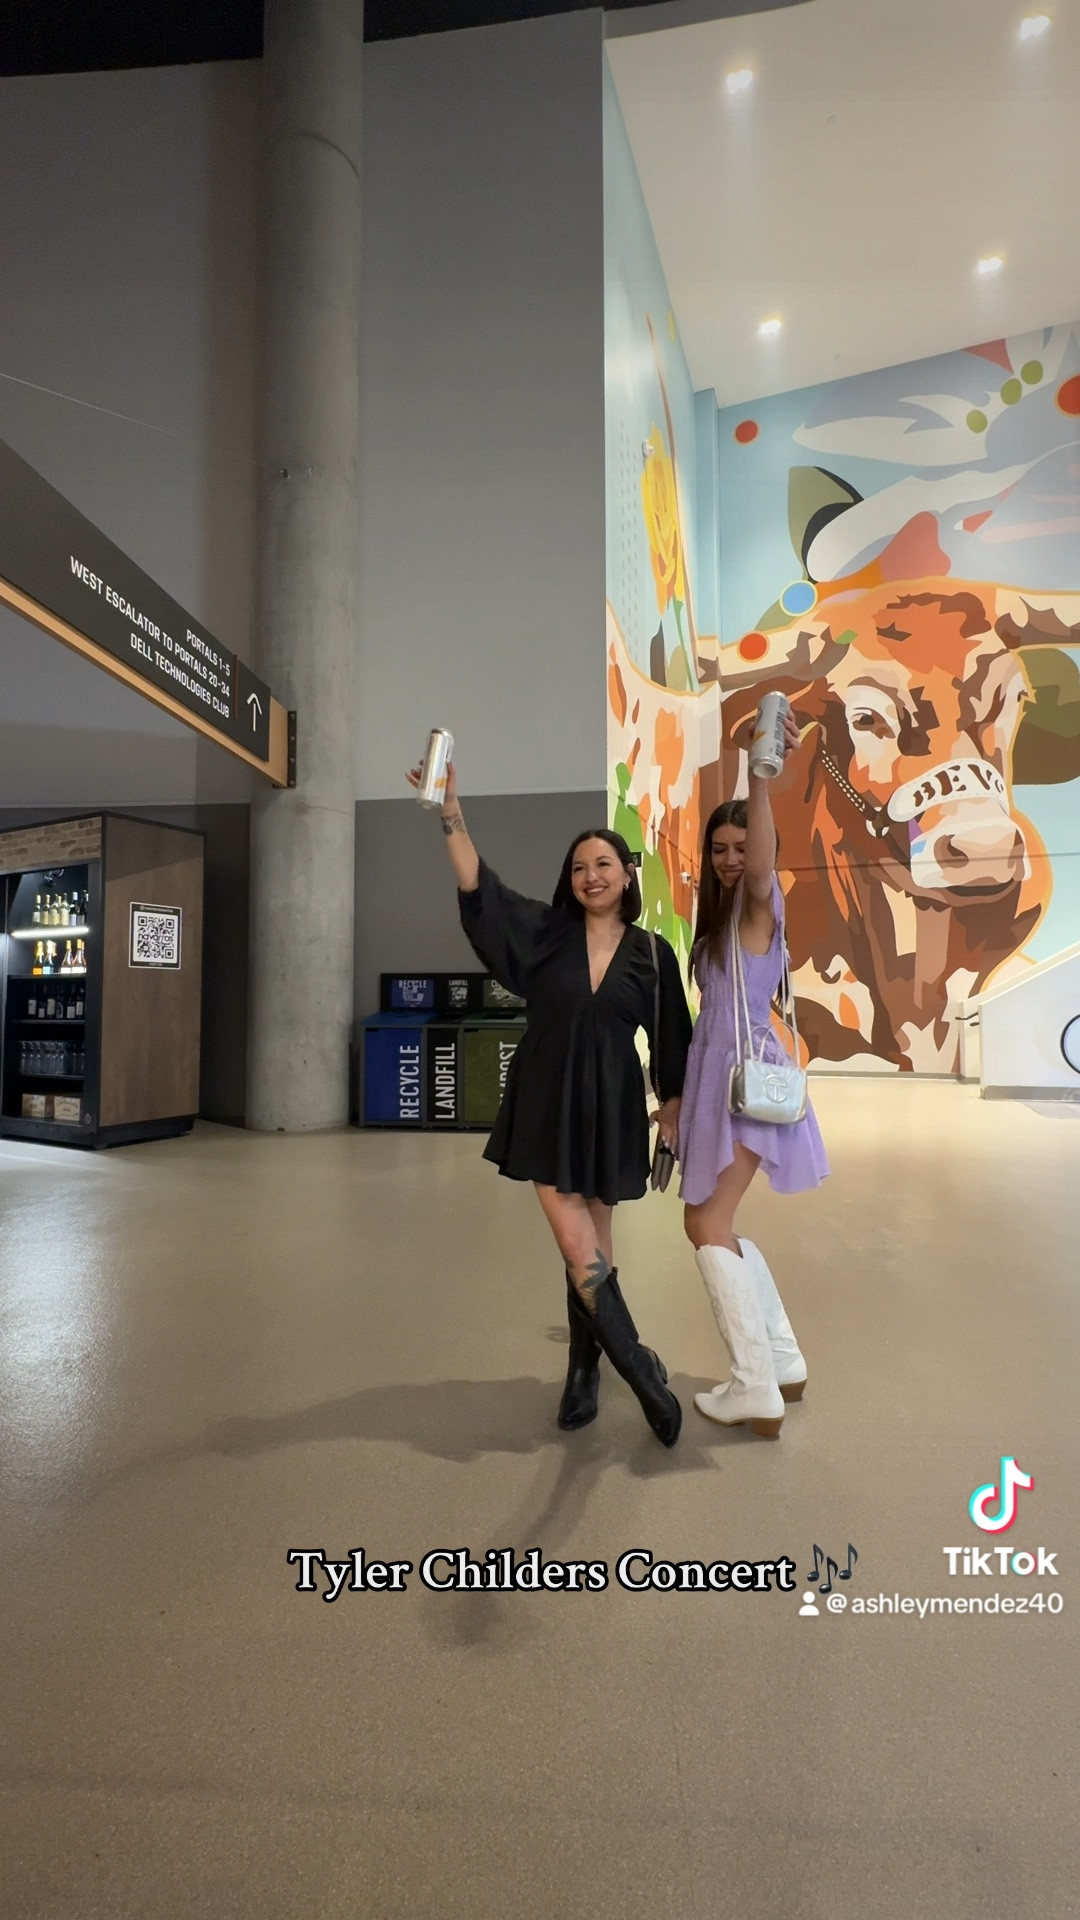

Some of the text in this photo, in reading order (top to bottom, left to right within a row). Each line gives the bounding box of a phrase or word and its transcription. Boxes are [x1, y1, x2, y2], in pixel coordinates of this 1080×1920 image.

[70, 555, 230, 697] WEST ESCALATOR TO PORTALS 20-34
[186, 628, 231, 677] PORTALS 1-5
[130, 632, 230, 719] DELL TECHNOLOGIES CLUB
[398, 979, 427, 989] RECYCLE
[399, 1044, 420, 1119] RECYCLE
[434, 1042, 456, 1119] LANDFILL
